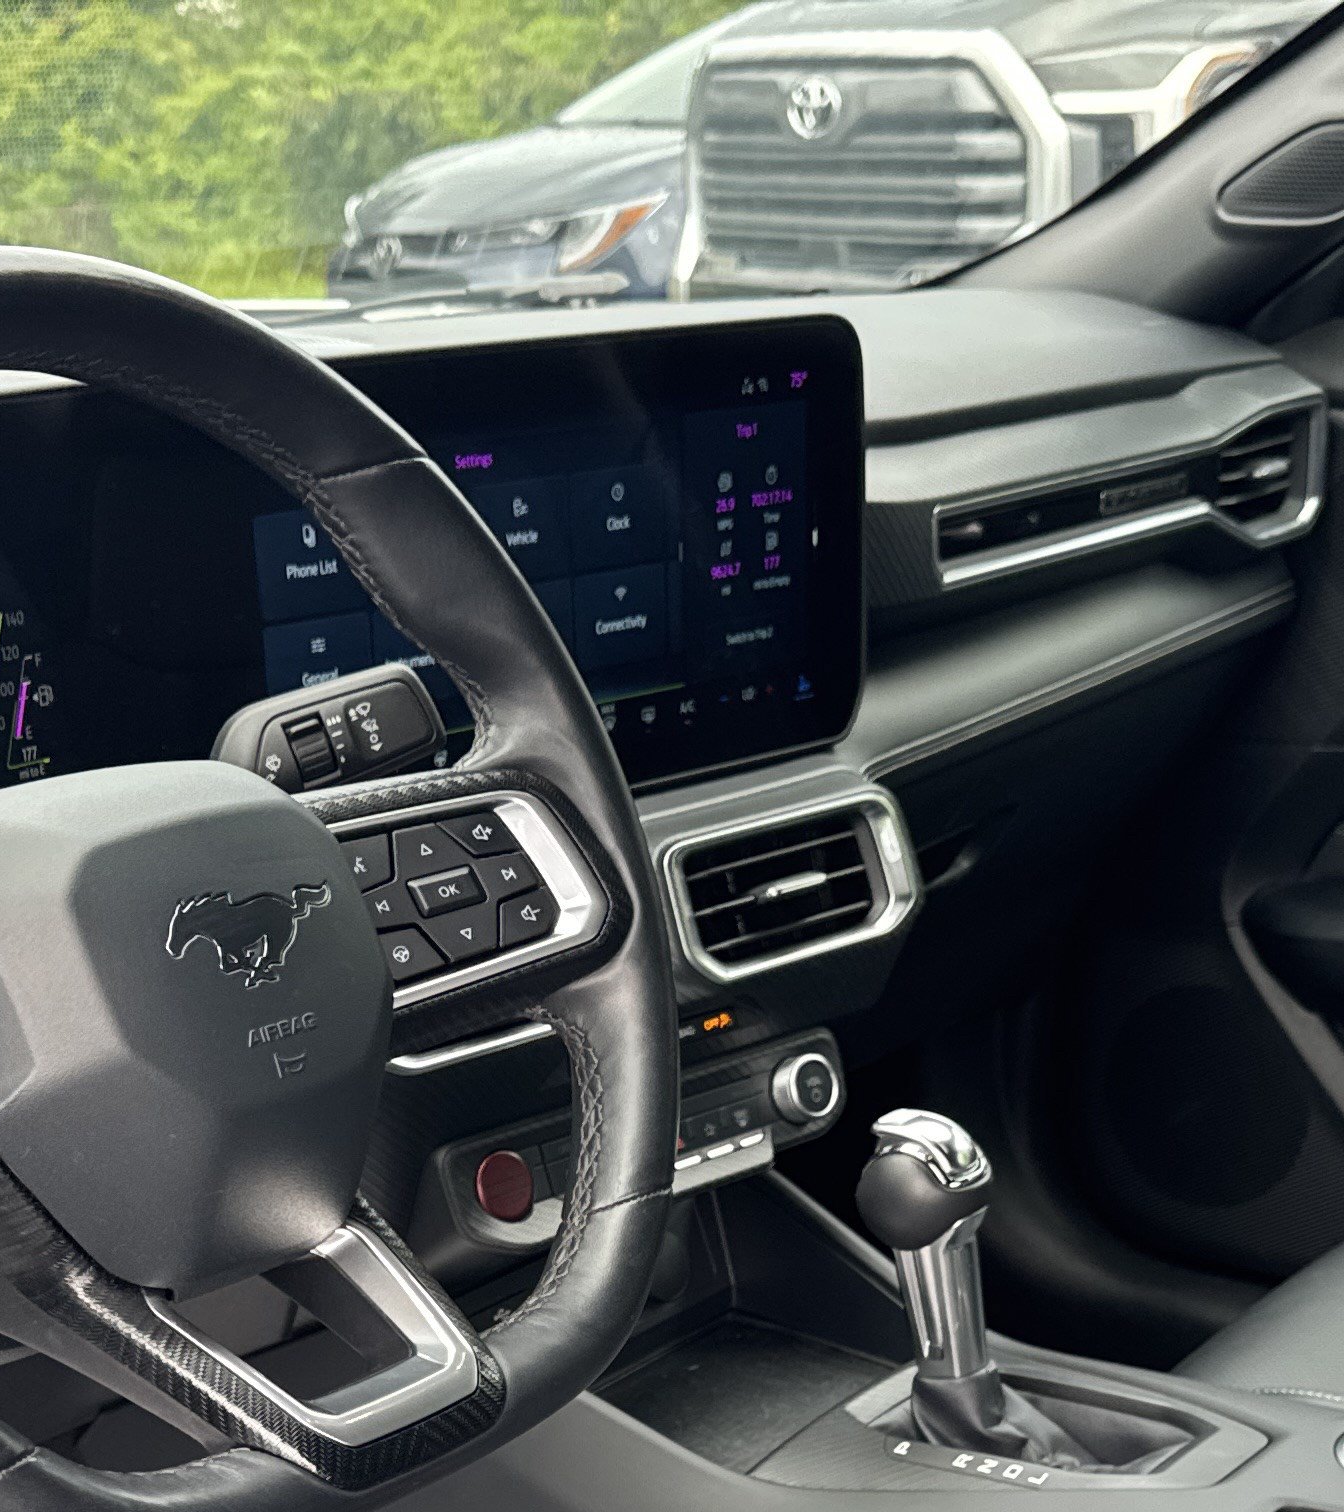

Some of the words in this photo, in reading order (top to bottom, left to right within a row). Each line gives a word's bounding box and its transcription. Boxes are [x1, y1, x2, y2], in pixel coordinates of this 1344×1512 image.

[455, 452, 494, 469] Settings
[606, 515, 631, 532] Clock
[505, 530, 539, 547] Vehicle
[286, 561, 318, 580] Phone
[319, 560, 338, 575] List
[5, 609, 25, 627] 140
[595, 613, 648, 636] Connectivity
[1, 645, 20, 662] 120
[438, 883, 462, 898] OK
[247, 1011, 320, 1049] AIRBAG
[893, 1441, 911, 1455] P
[952, 1453, 975, 1469] R
[976, 1458, 998, 1474] N
[1002, 1464, 1024, 1480] D
[1028, 1472, 1049, 1485] L
